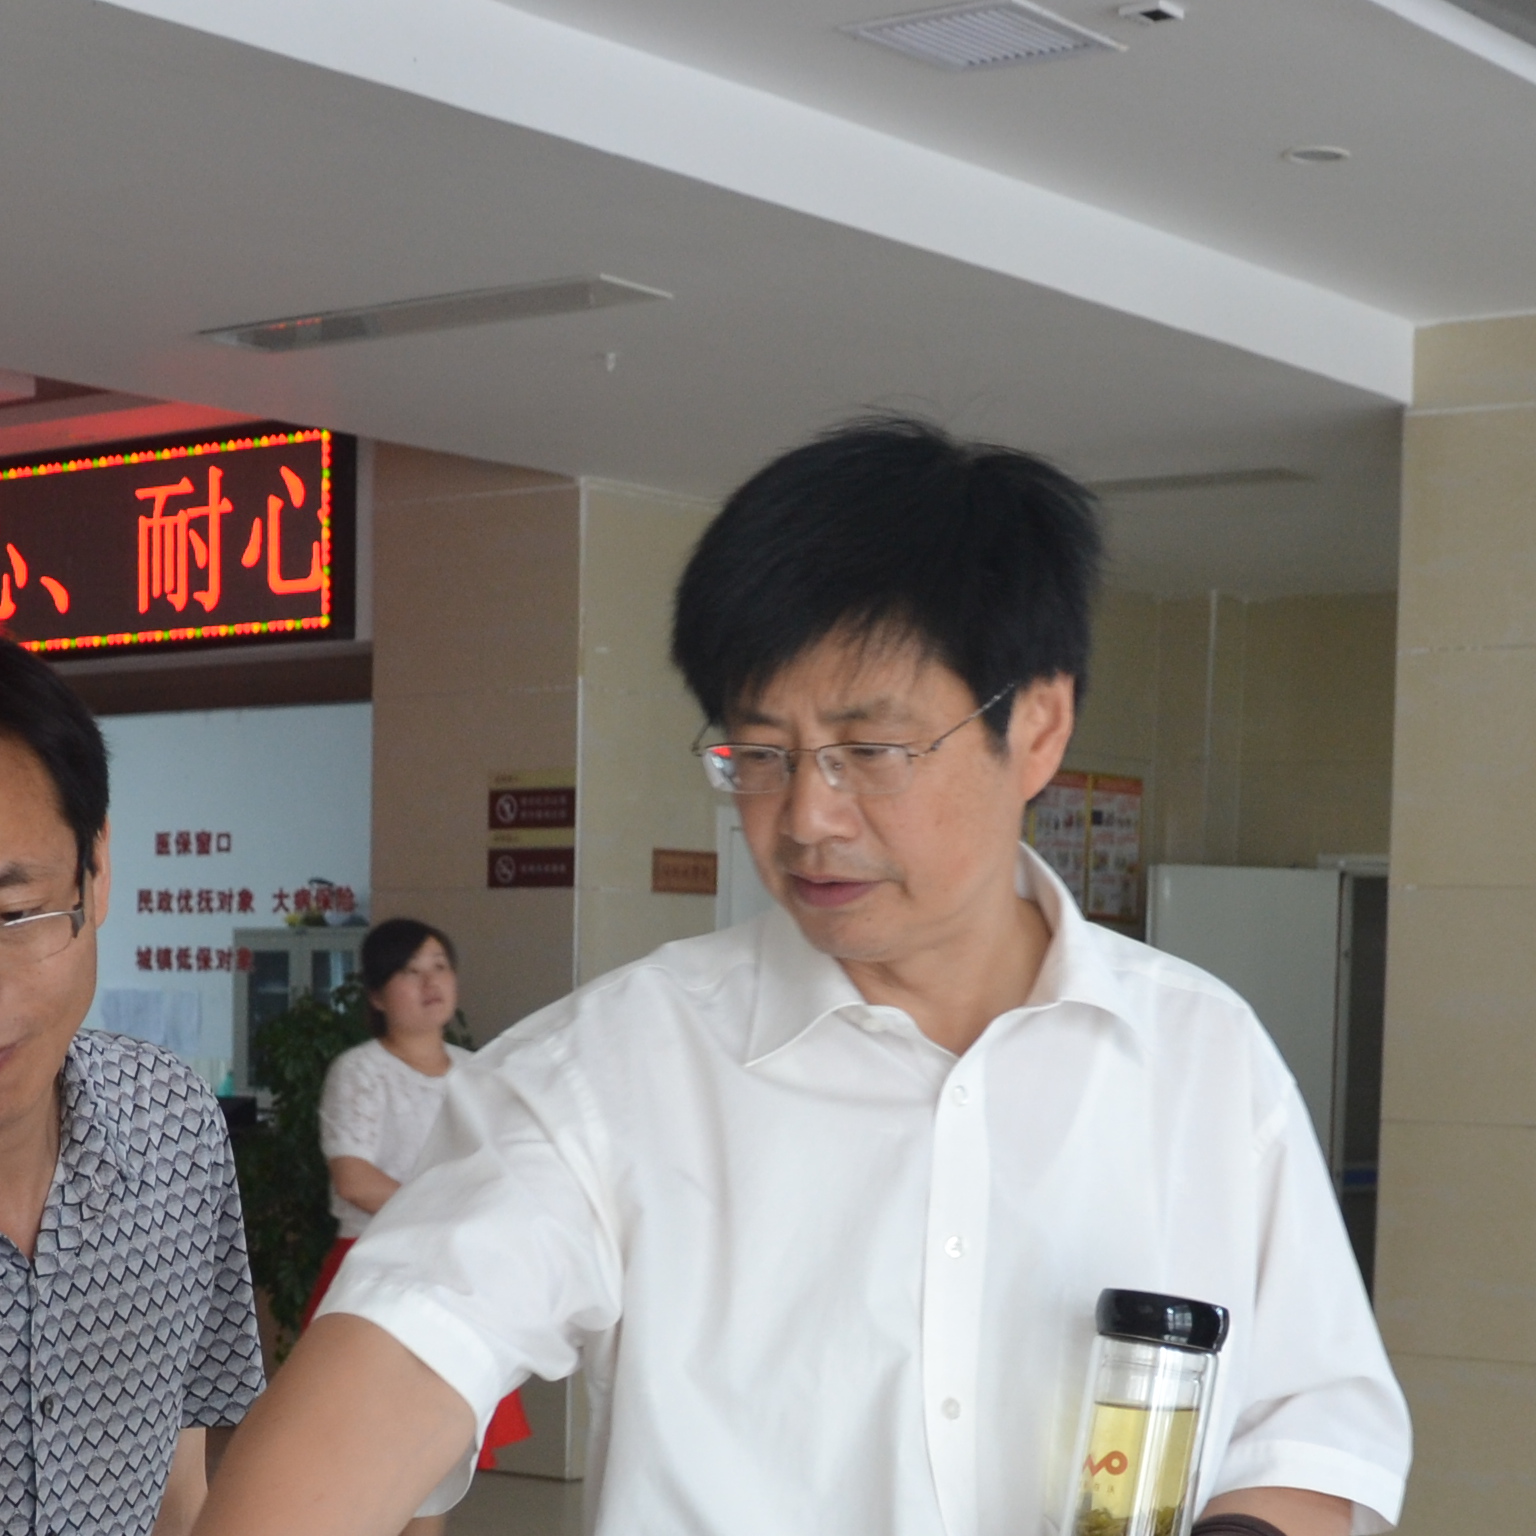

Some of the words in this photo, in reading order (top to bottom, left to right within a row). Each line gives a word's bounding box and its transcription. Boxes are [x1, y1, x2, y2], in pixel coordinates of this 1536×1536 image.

[155, 830, 232, 856] 医保窗口
[137, 888, 255, 914] 民政优抚对象
